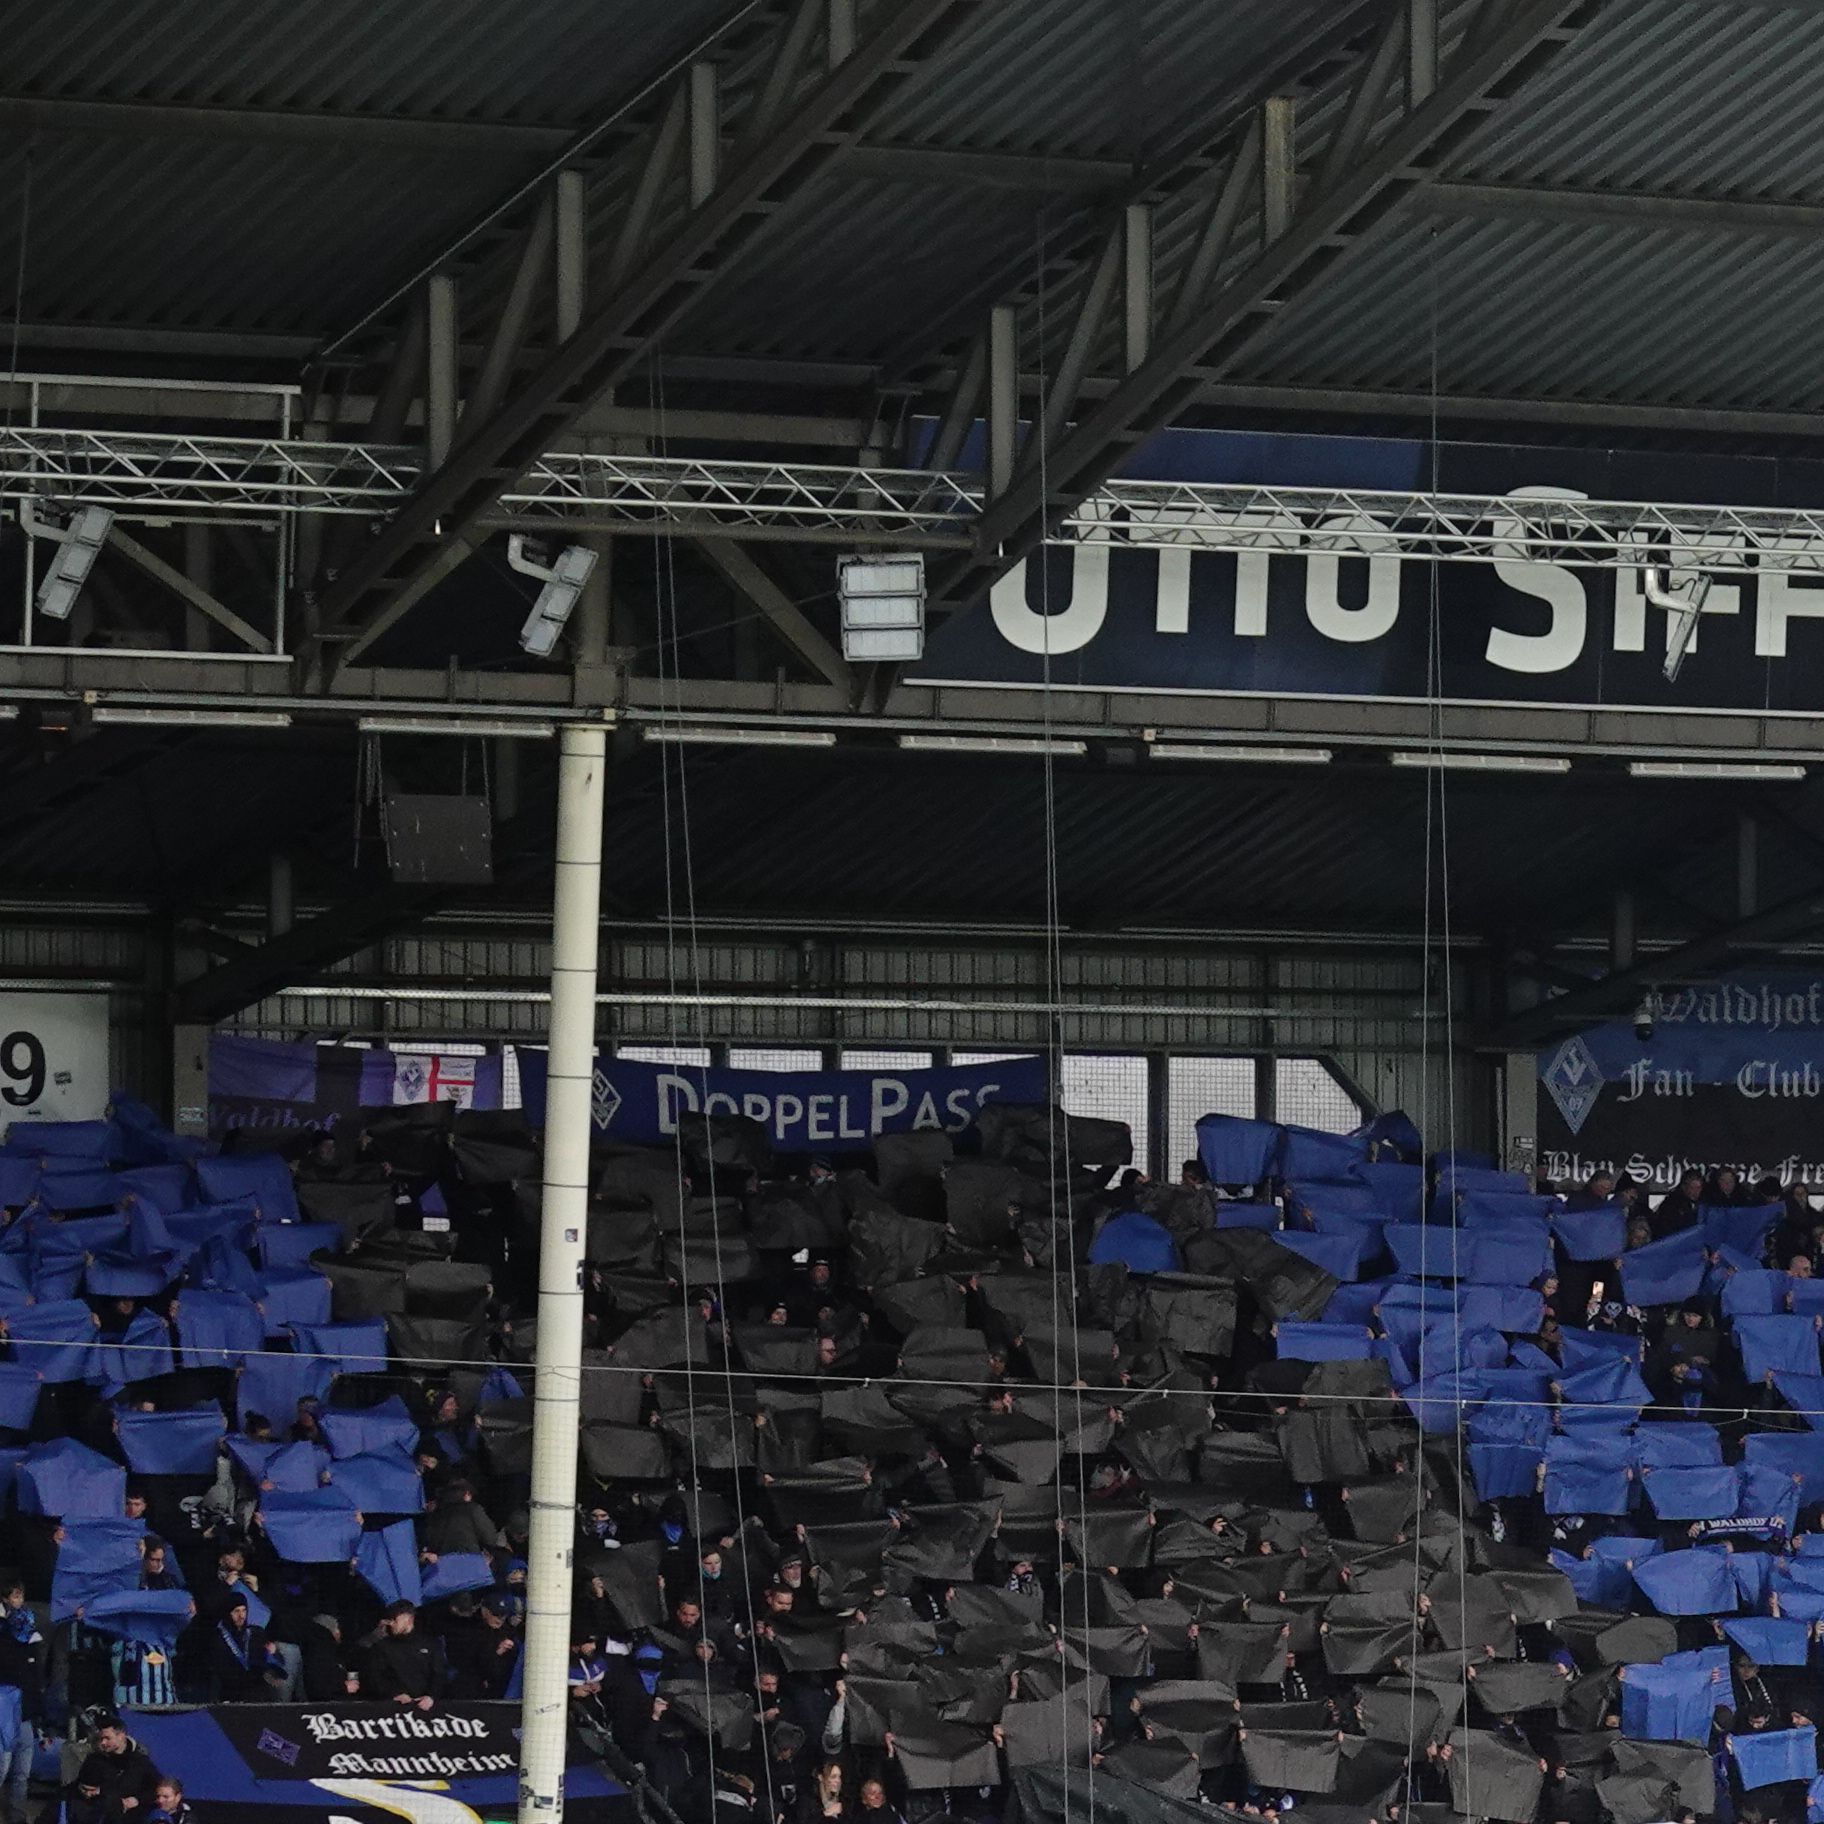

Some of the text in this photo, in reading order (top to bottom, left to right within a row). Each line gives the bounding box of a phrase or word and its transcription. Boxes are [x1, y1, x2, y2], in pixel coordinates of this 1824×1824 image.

[1616, 1056, 1822, 1104] Fan Club
[301, 1712, 491, 1745] Barrikade
[327, 1751, 518, 1777] Mannheim
